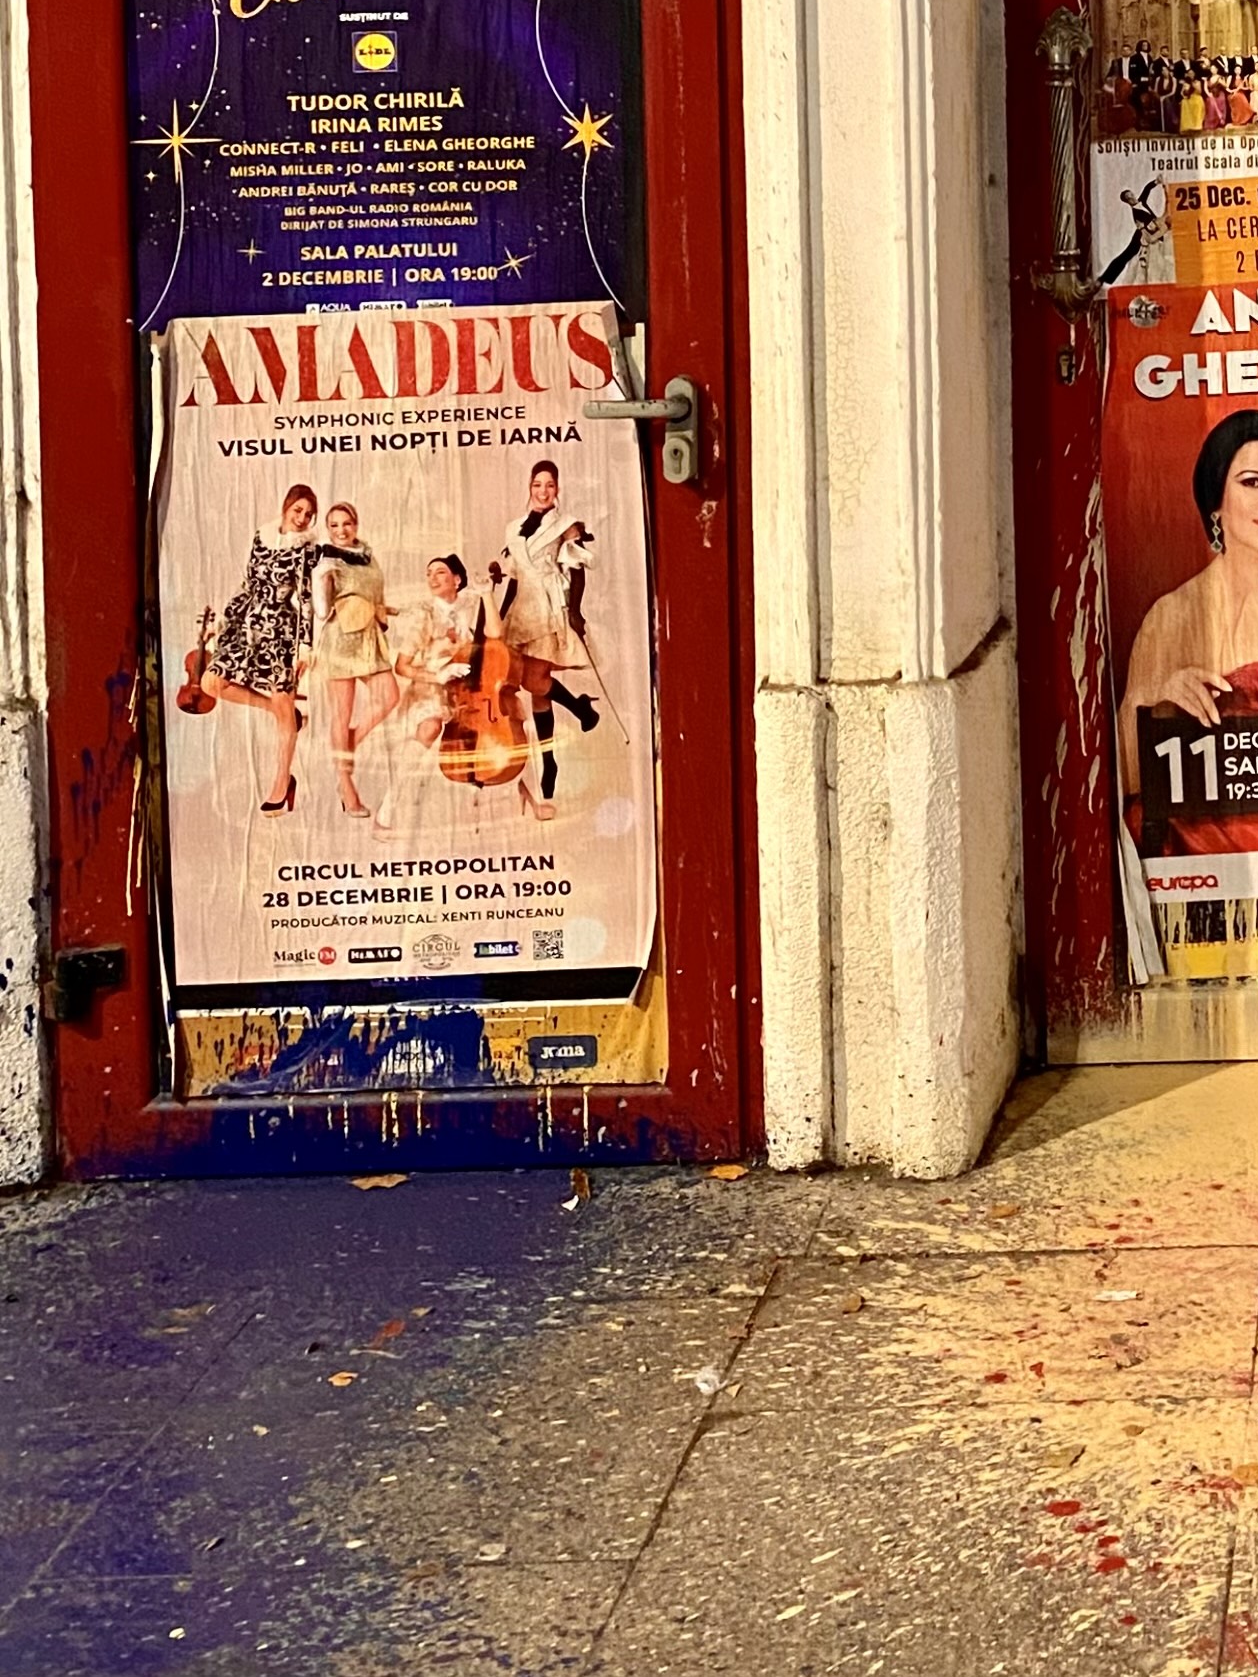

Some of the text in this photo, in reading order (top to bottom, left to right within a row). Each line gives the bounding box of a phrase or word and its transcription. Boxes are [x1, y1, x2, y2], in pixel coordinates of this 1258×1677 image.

[358, 45, 392, 58] LIDL
[287, 87, 464, 112] TUDOR CHIRILĂ
[311, 115, 443, 134] IRINA RIMES
[219, 136, 536, 156] CONNECT-R FELI ELENA GHEORGHE
[230, 158, 526, 178] MISHA MILLER JO AMI SORE RALUKA
[238, 184, 293, 199] ANDREI
[428, 181, 458, 194] COR
[462, 180, 481, 193] CU
[485, 180, 518, 193] DOR
[1174, 185, 1200, 212] 25
[1207, 184, 1251, 209] Dec.
[1198, 218, 1219, 243] LA
[301, 243, 458, 261] SALA PALATULUI
[1235, 251, 1246, 274] 2
[262, 266, 498, 287] 2 DECEMBRIE ORA 19:00
[181, 311, 613, 407] AMADEUS
[274, 405, 526, 431] SYMPHONIC EXPERIENCE
[218, 421, 583, 458] VISUL UNEI NOPȚI DE IARNĂ
[1154, 734, 1219, 804] 11
[278, 854, 555, 883] CIRCUL METROPOLITAN
[262, 880, 573, 909] 28 DECEMBRIE ORA 19:00
[1146, 874, 1218, 892] europa
[271, 915, 368, 929] PRODUCĂTOR
[442, 911, 482, 923] XENTI
[486, 908, 565, 921] RUNCEANU
